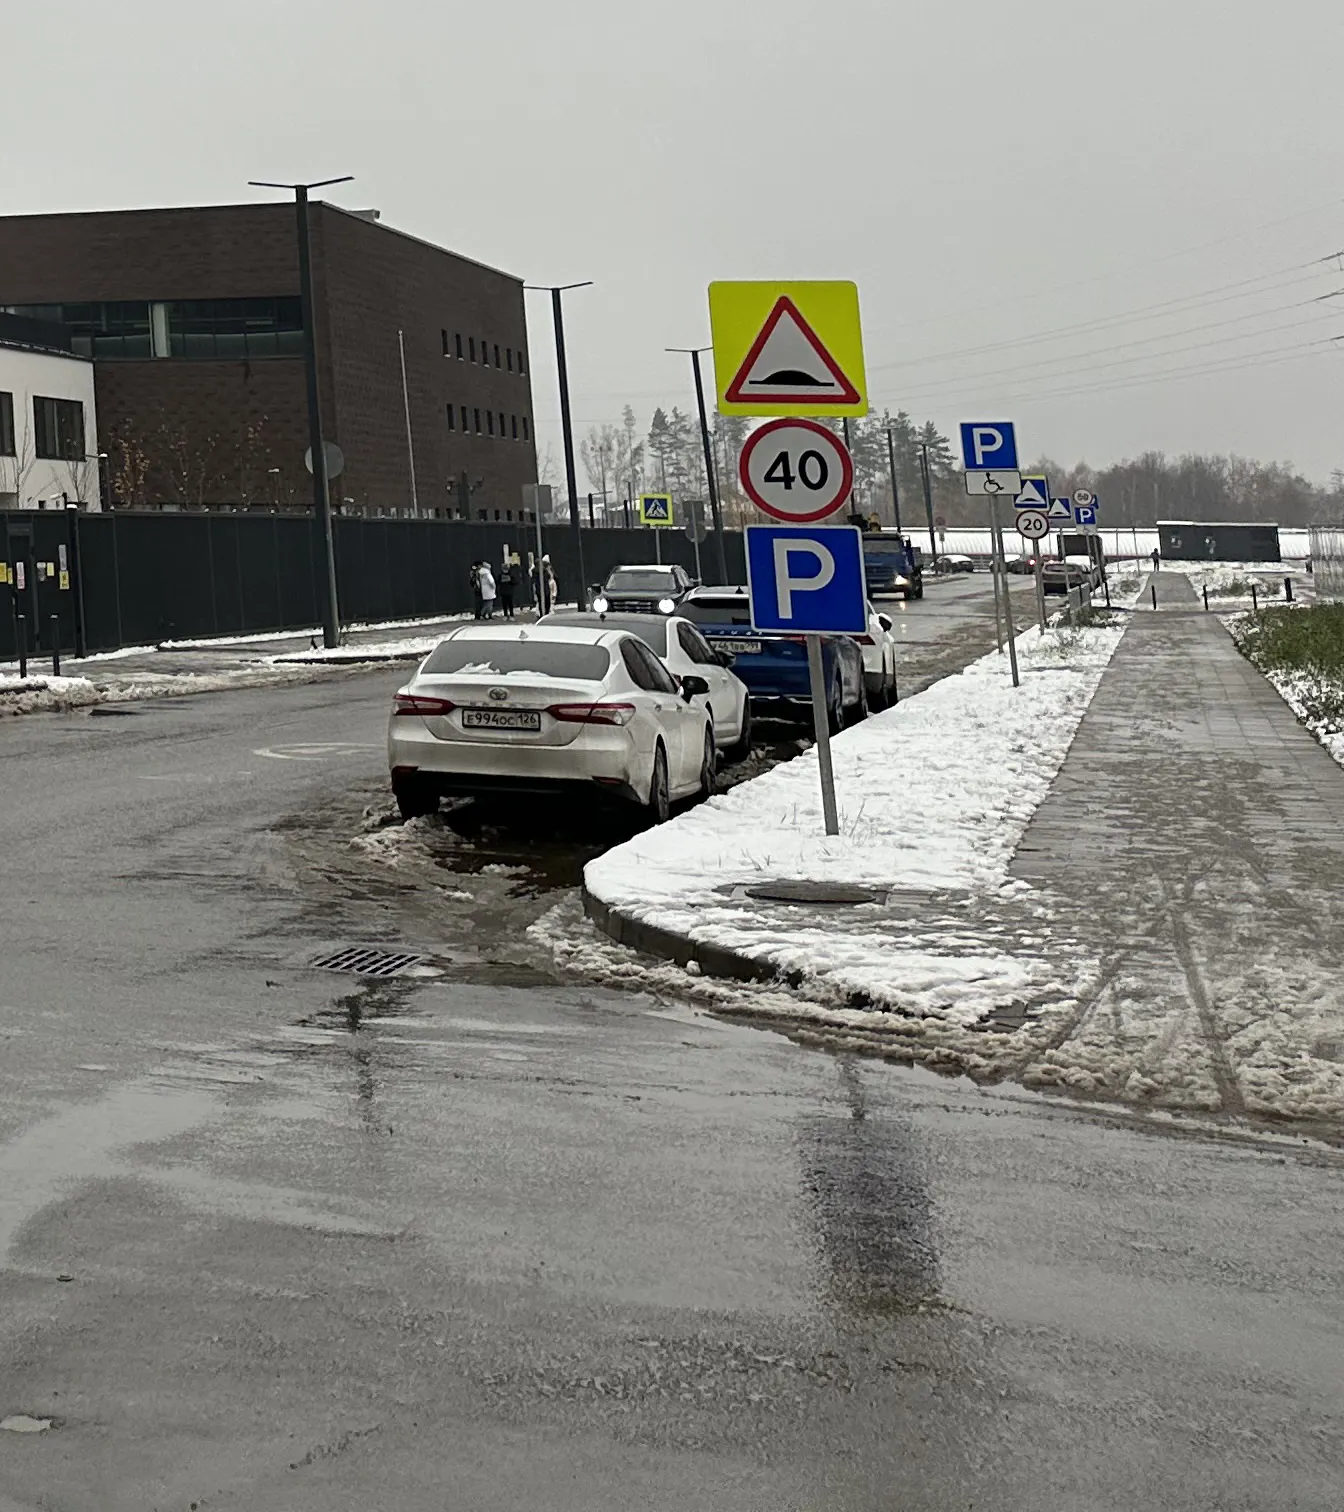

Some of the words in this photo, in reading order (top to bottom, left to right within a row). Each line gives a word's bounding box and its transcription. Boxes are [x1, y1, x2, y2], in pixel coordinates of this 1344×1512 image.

[972, 427, 1004, 465] P
[763, 449, 829, 491] 40
[1022, 518, 1043, 531] 20
[1079, 508, 1092, 523] P
[772, 538, 836, 620] P
